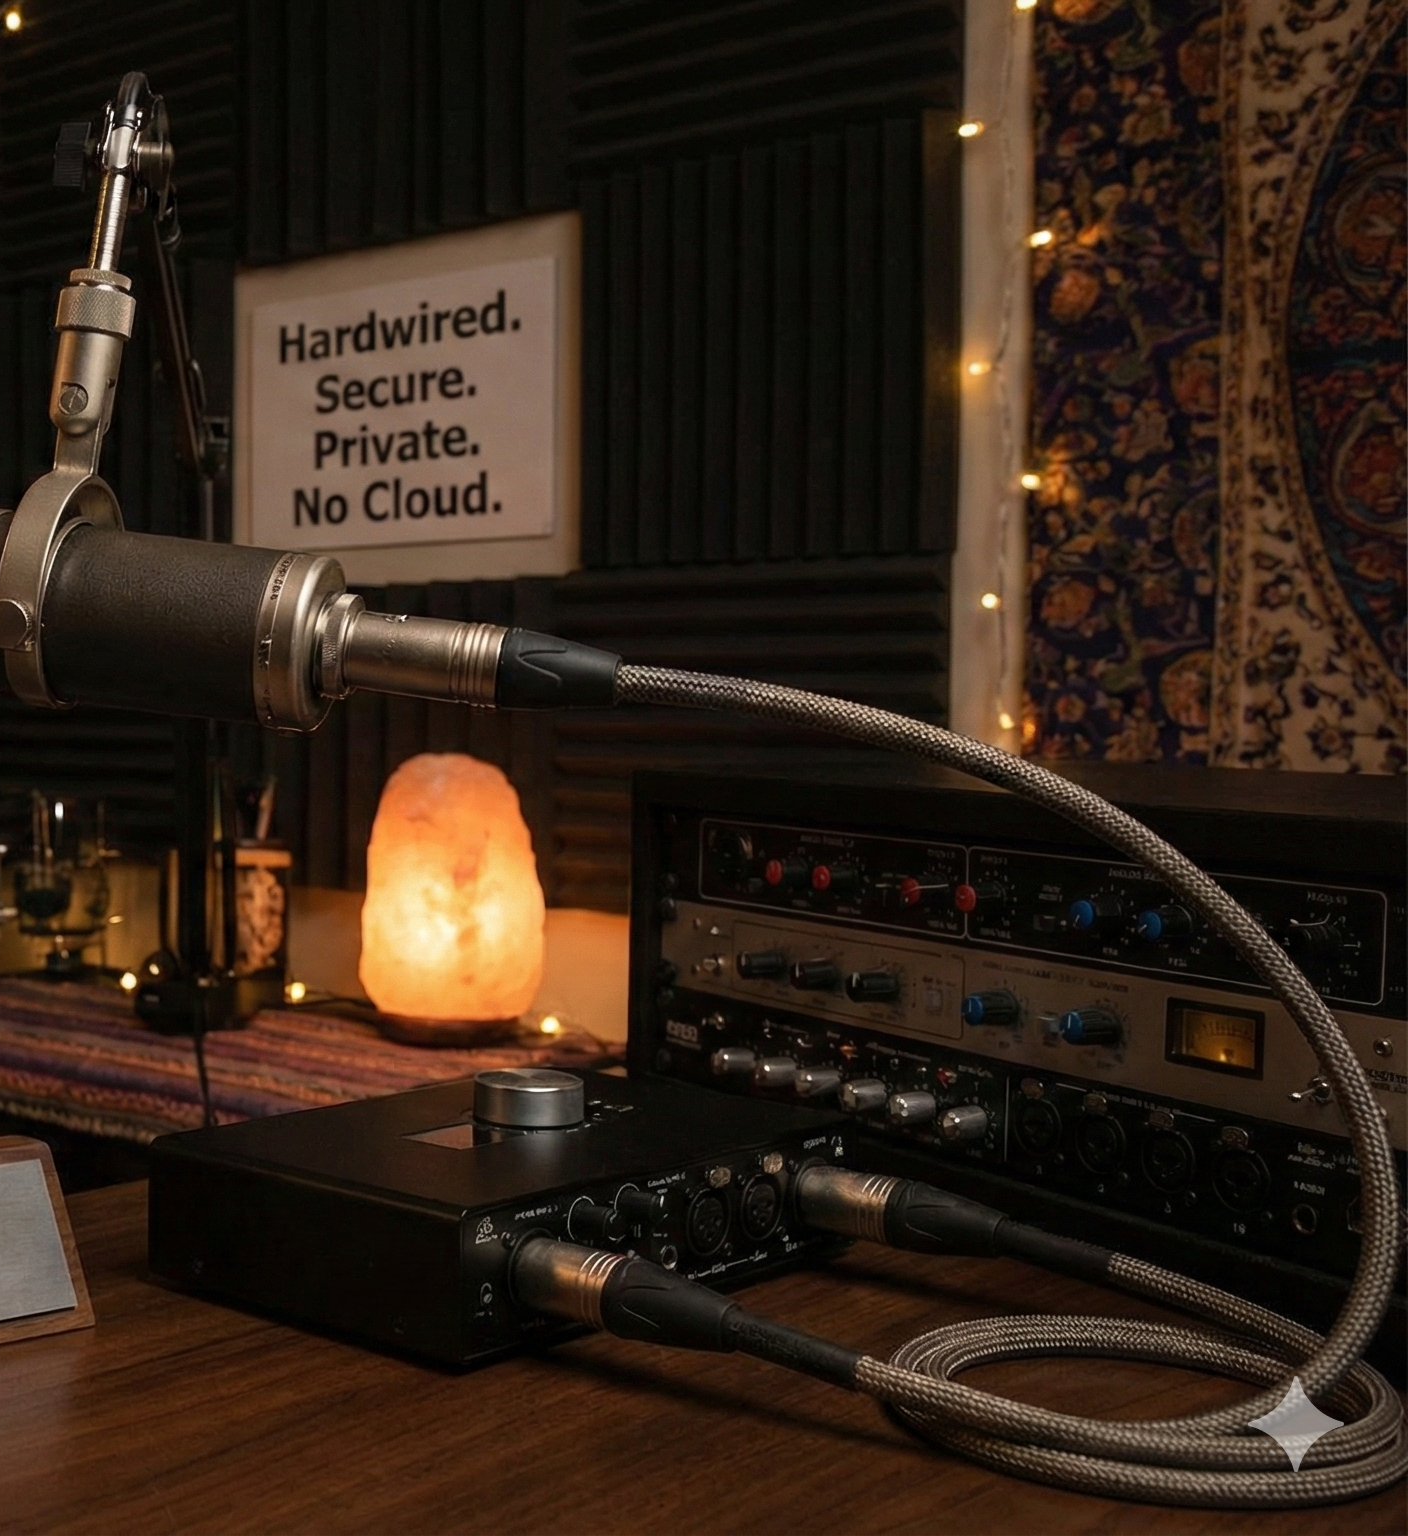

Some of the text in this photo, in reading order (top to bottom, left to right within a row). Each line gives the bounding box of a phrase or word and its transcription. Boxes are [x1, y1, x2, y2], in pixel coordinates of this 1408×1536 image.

[278, 289, 522, 365] Hardwired.
[315, 366, 477, 415] Secure.
[314, 420, 480, 470] Private.
[293, 470, 503, 527] No Cloud.
